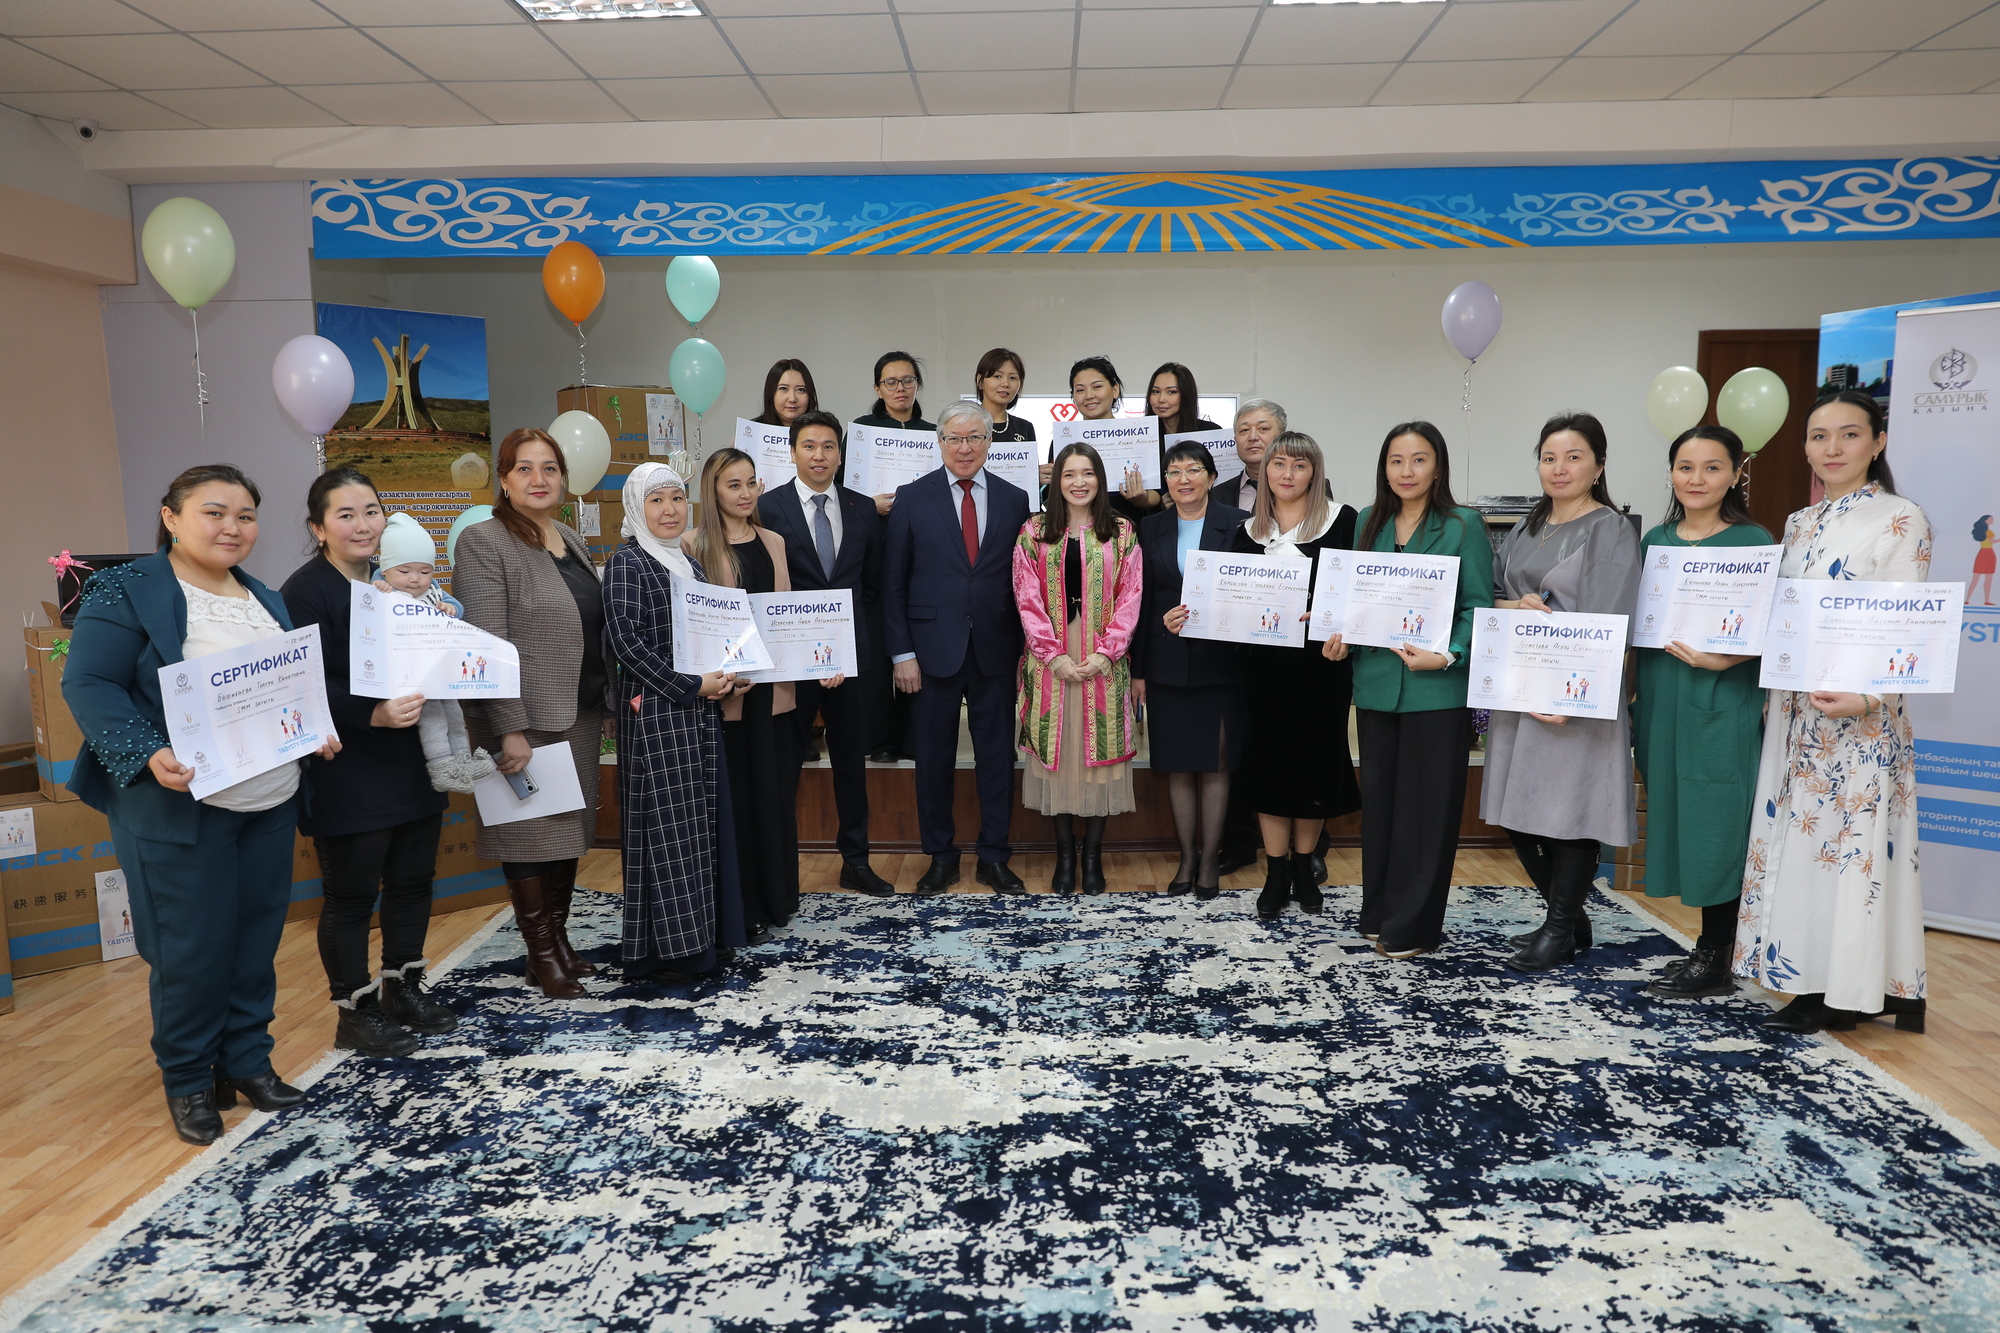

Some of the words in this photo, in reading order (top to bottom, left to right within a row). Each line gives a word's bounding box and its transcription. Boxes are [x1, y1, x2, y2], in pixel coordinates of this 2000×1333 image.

[1083, 427, 1149, 439] СЕРТИФИКАТ
[1219, 565, 1299, 580] СЕРТИФИКАТ
[1356, 564, 1446, 580] СЕРТИФИКАТ
[1683, 562, 1770, 574] СЕРТИФИКАТ
[685, 592, 741, 611] СЕРТИФИКАТ
[766, 603, 842, 615] СЕРТИФИКАТ
[1819, 596, 1946, 612] СЕРТИФИКАТ
[1515, 624, 1613, 641] СЕРТИФИКАТ
[210, 646, 309, 687] СЕРТИФИКАТ
[277, 742, 300, 754] TABYSTY
[300, 734, 319, 746] OTBASY
